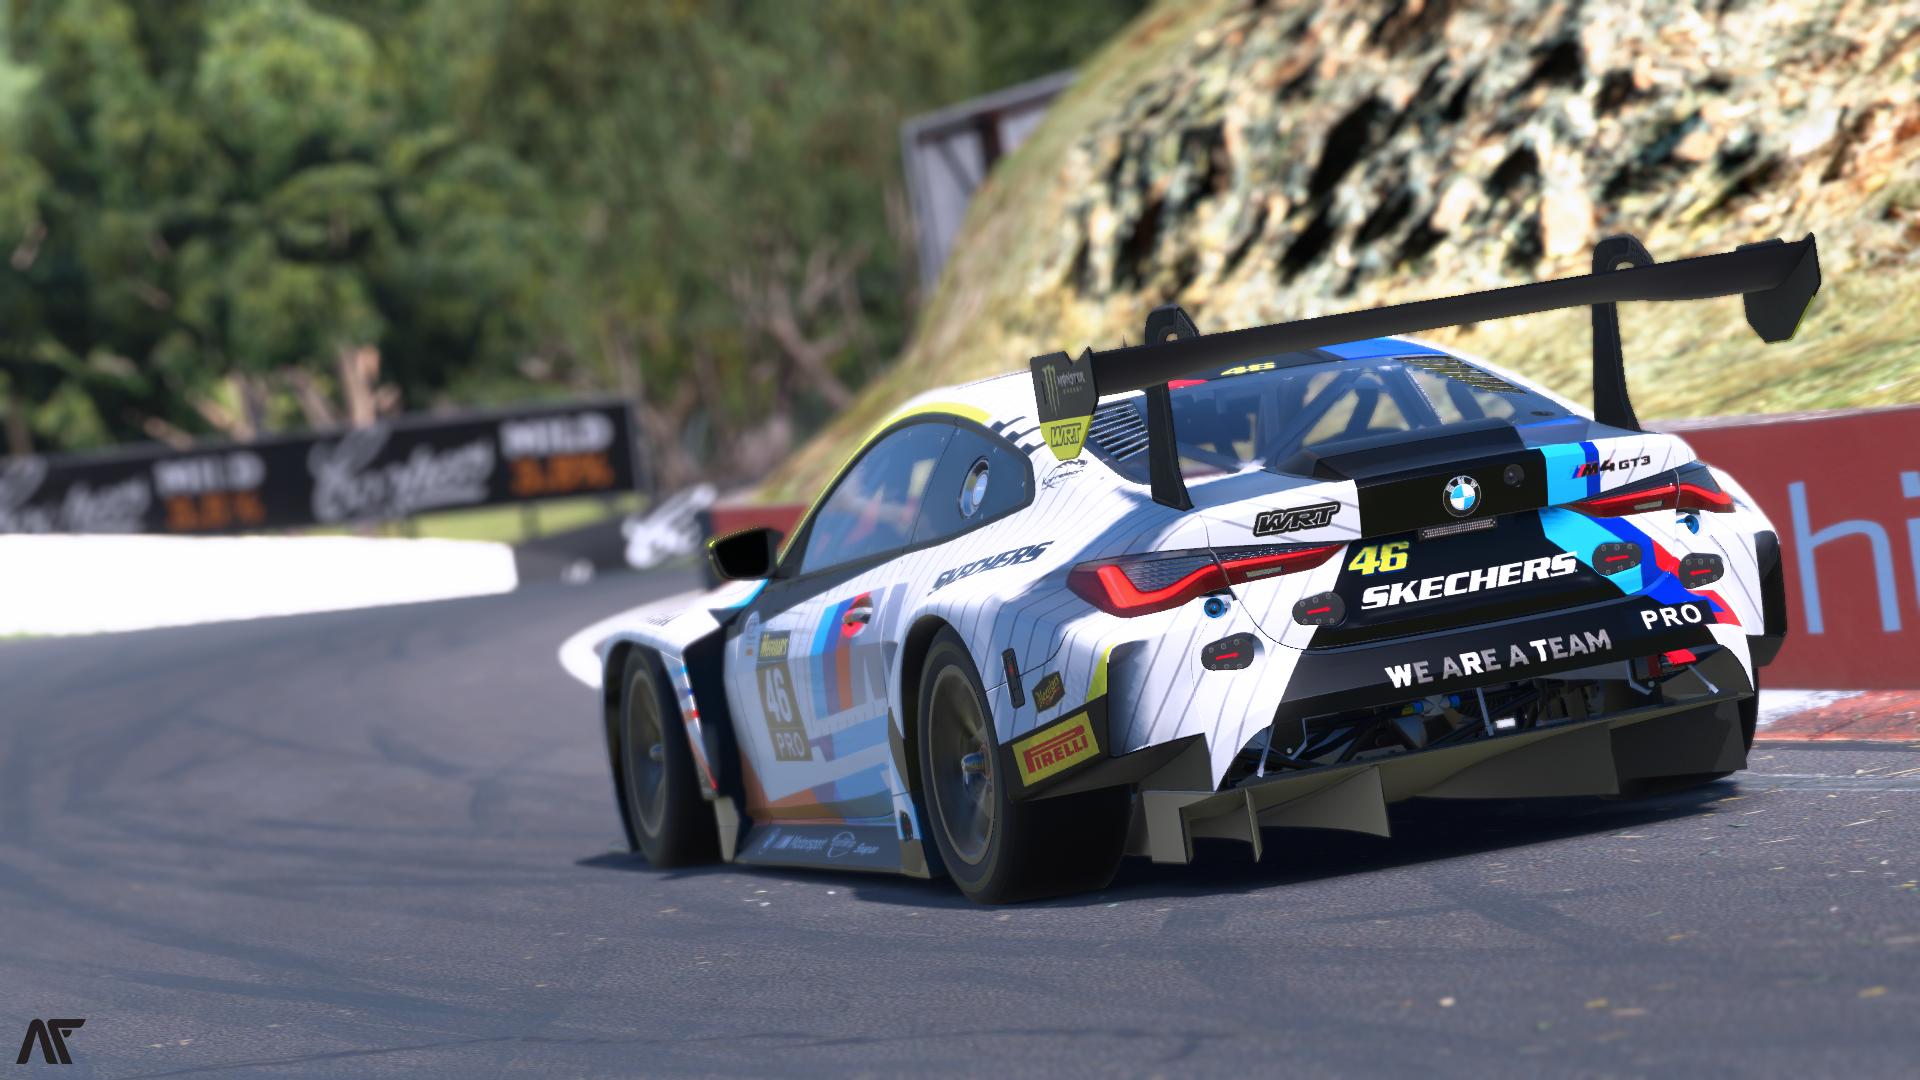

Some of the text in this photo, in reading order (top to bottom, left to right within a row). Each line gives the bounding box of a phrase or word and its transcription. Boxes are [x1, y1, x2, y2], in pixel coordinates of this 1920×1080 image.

[1050, 422, 1082, 448] WRT
[1618, 455, 1651, 471] GT3
[1254, 501, 1341, 537] WRT
[1348, 541, 1410, 576] 46
[1361, 551, 1578, 610] SKECHERS
[1640, 603, 1702, 630] PRO
[1384, 628, 1613, 689] WE ARE A TEAM
[765, 667, 793, 723] 46
[775, 731, 806, 758] PRO
[1023, 725, 1089, 774] PIRELLI
